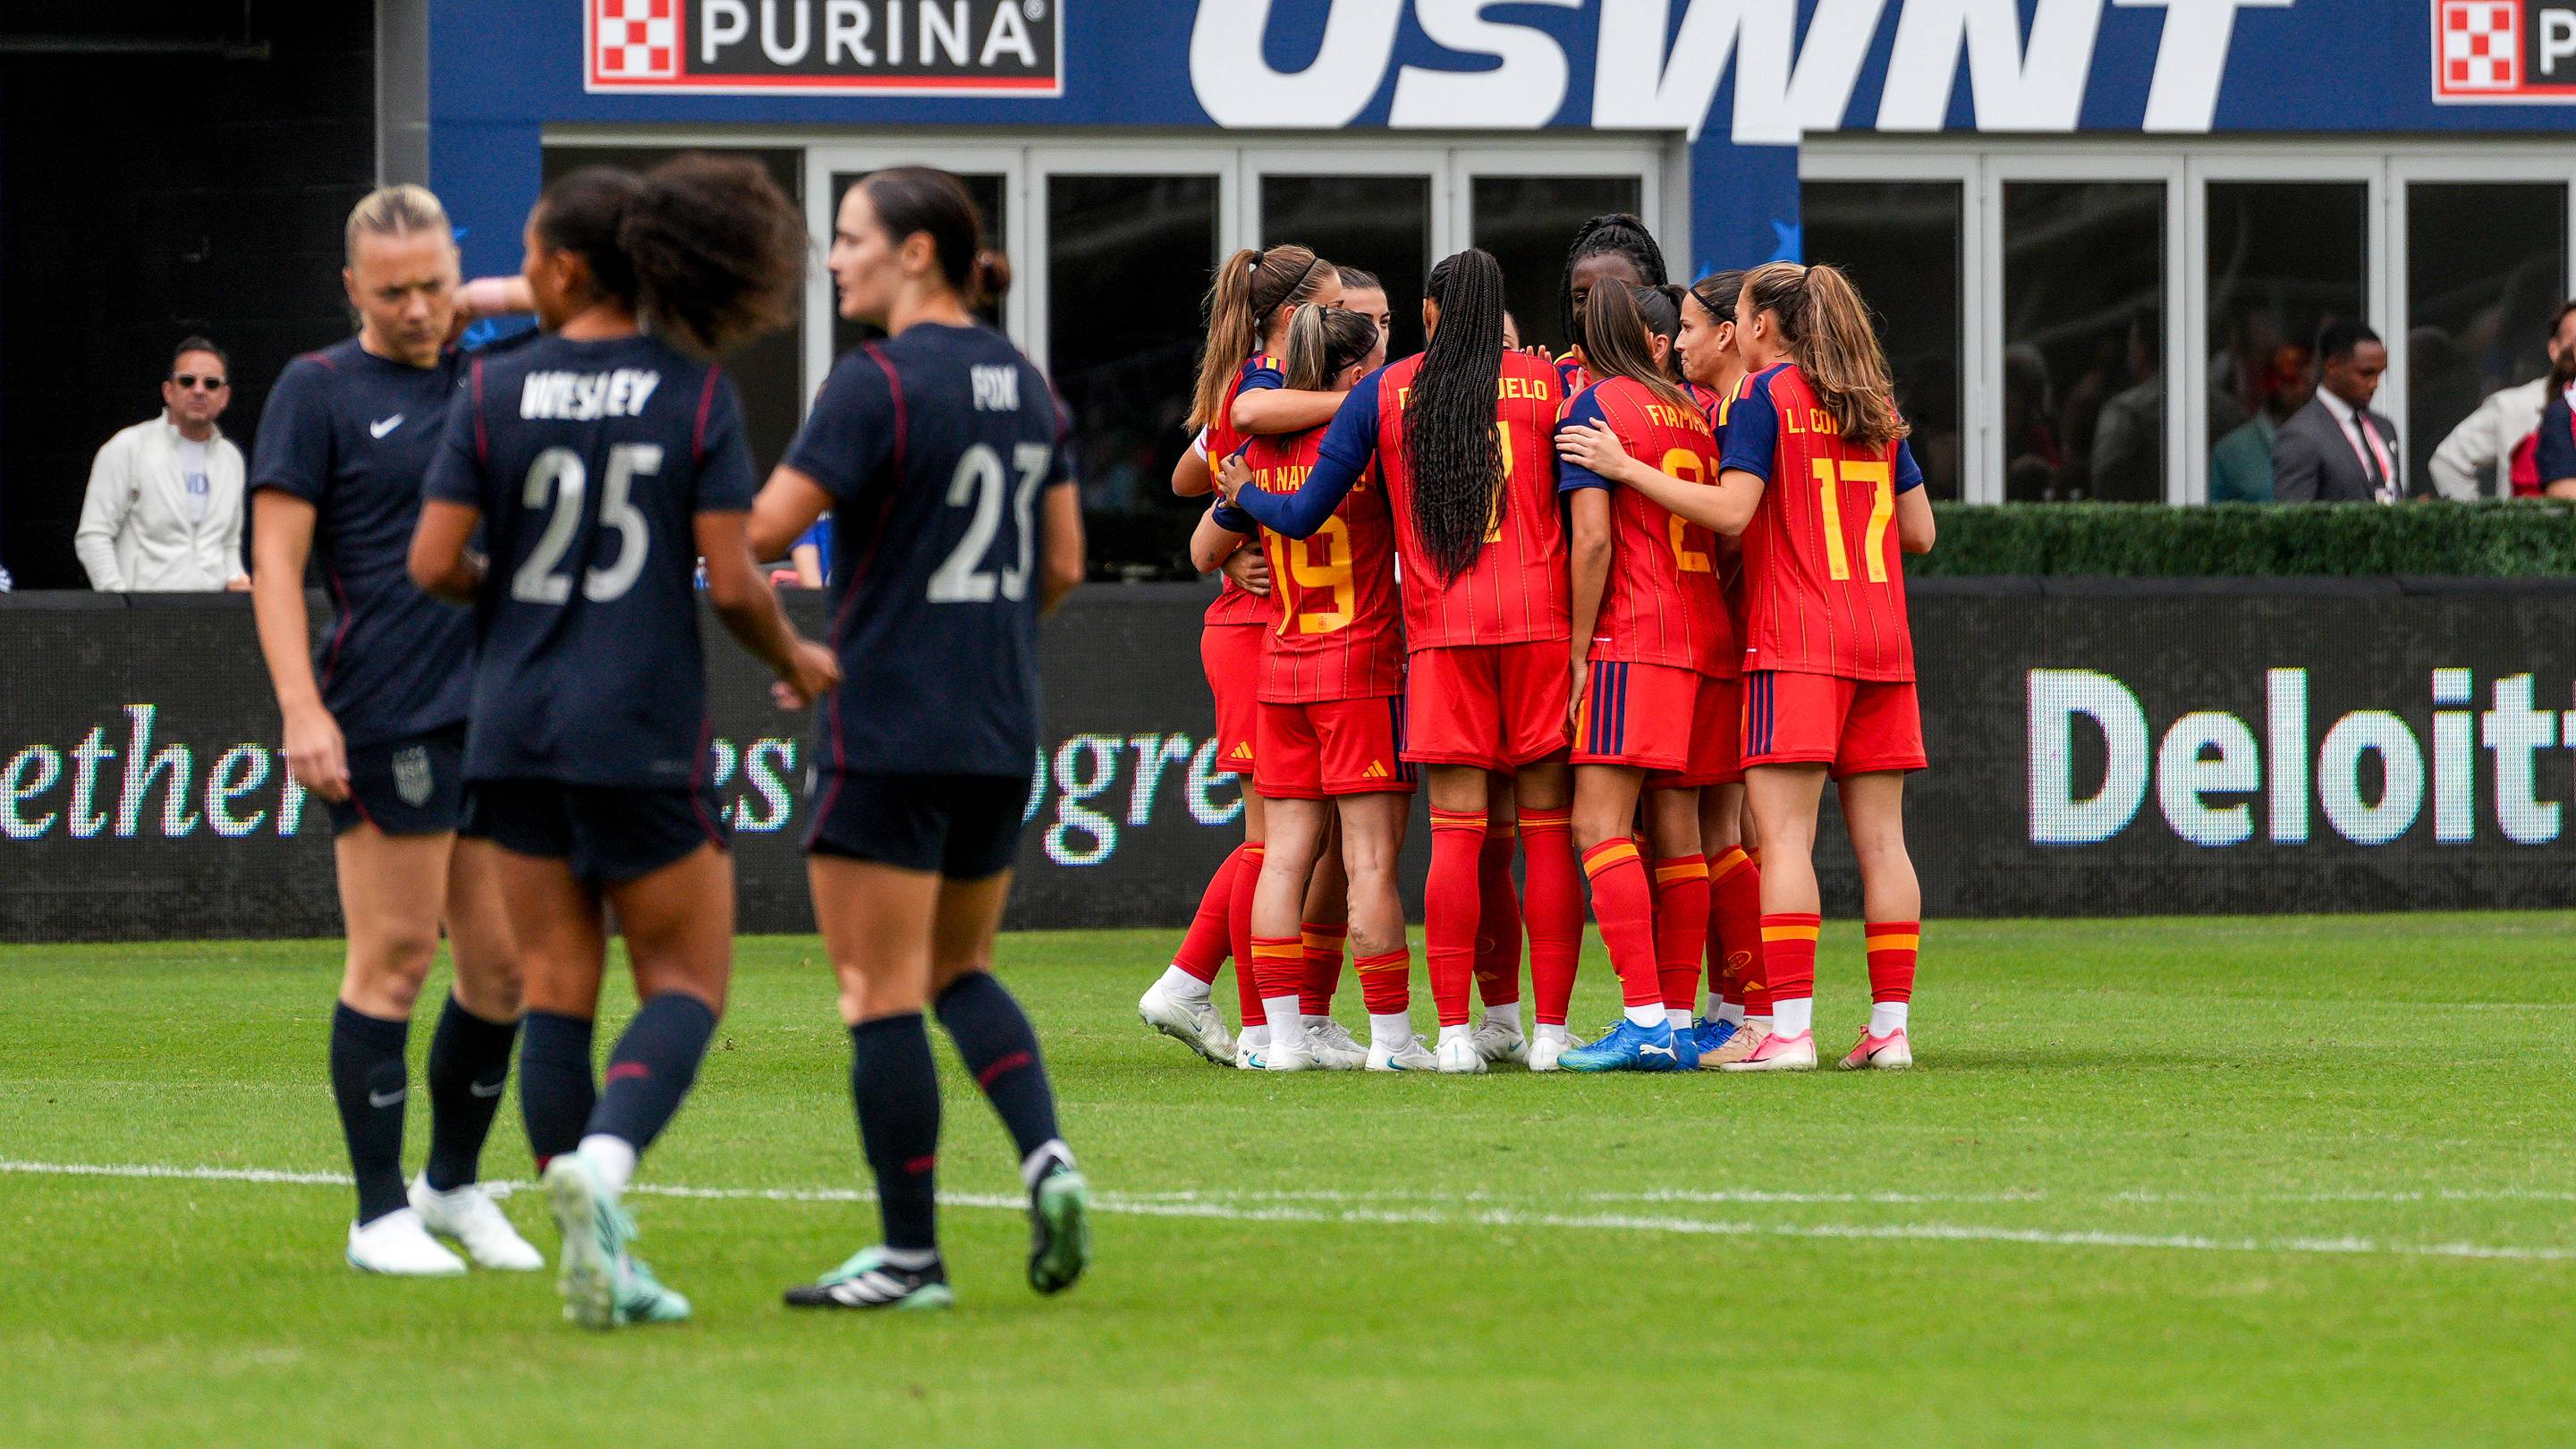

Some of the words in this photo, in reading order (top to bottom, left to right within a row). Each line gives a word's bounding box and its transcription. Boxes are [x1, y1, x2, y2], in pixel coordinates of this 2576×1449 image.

[1188, 0, 2295, 145] USWNT
[970, 364, 1021, 412] FOX
[1786, 409, 1805, 434] L.
[511, 442, 665, 606] 25
[1263, 514, 1355, 636] 19
[1812, 458, 1889, 583] 17
[2026, 667, 2576, 846] Deloit
